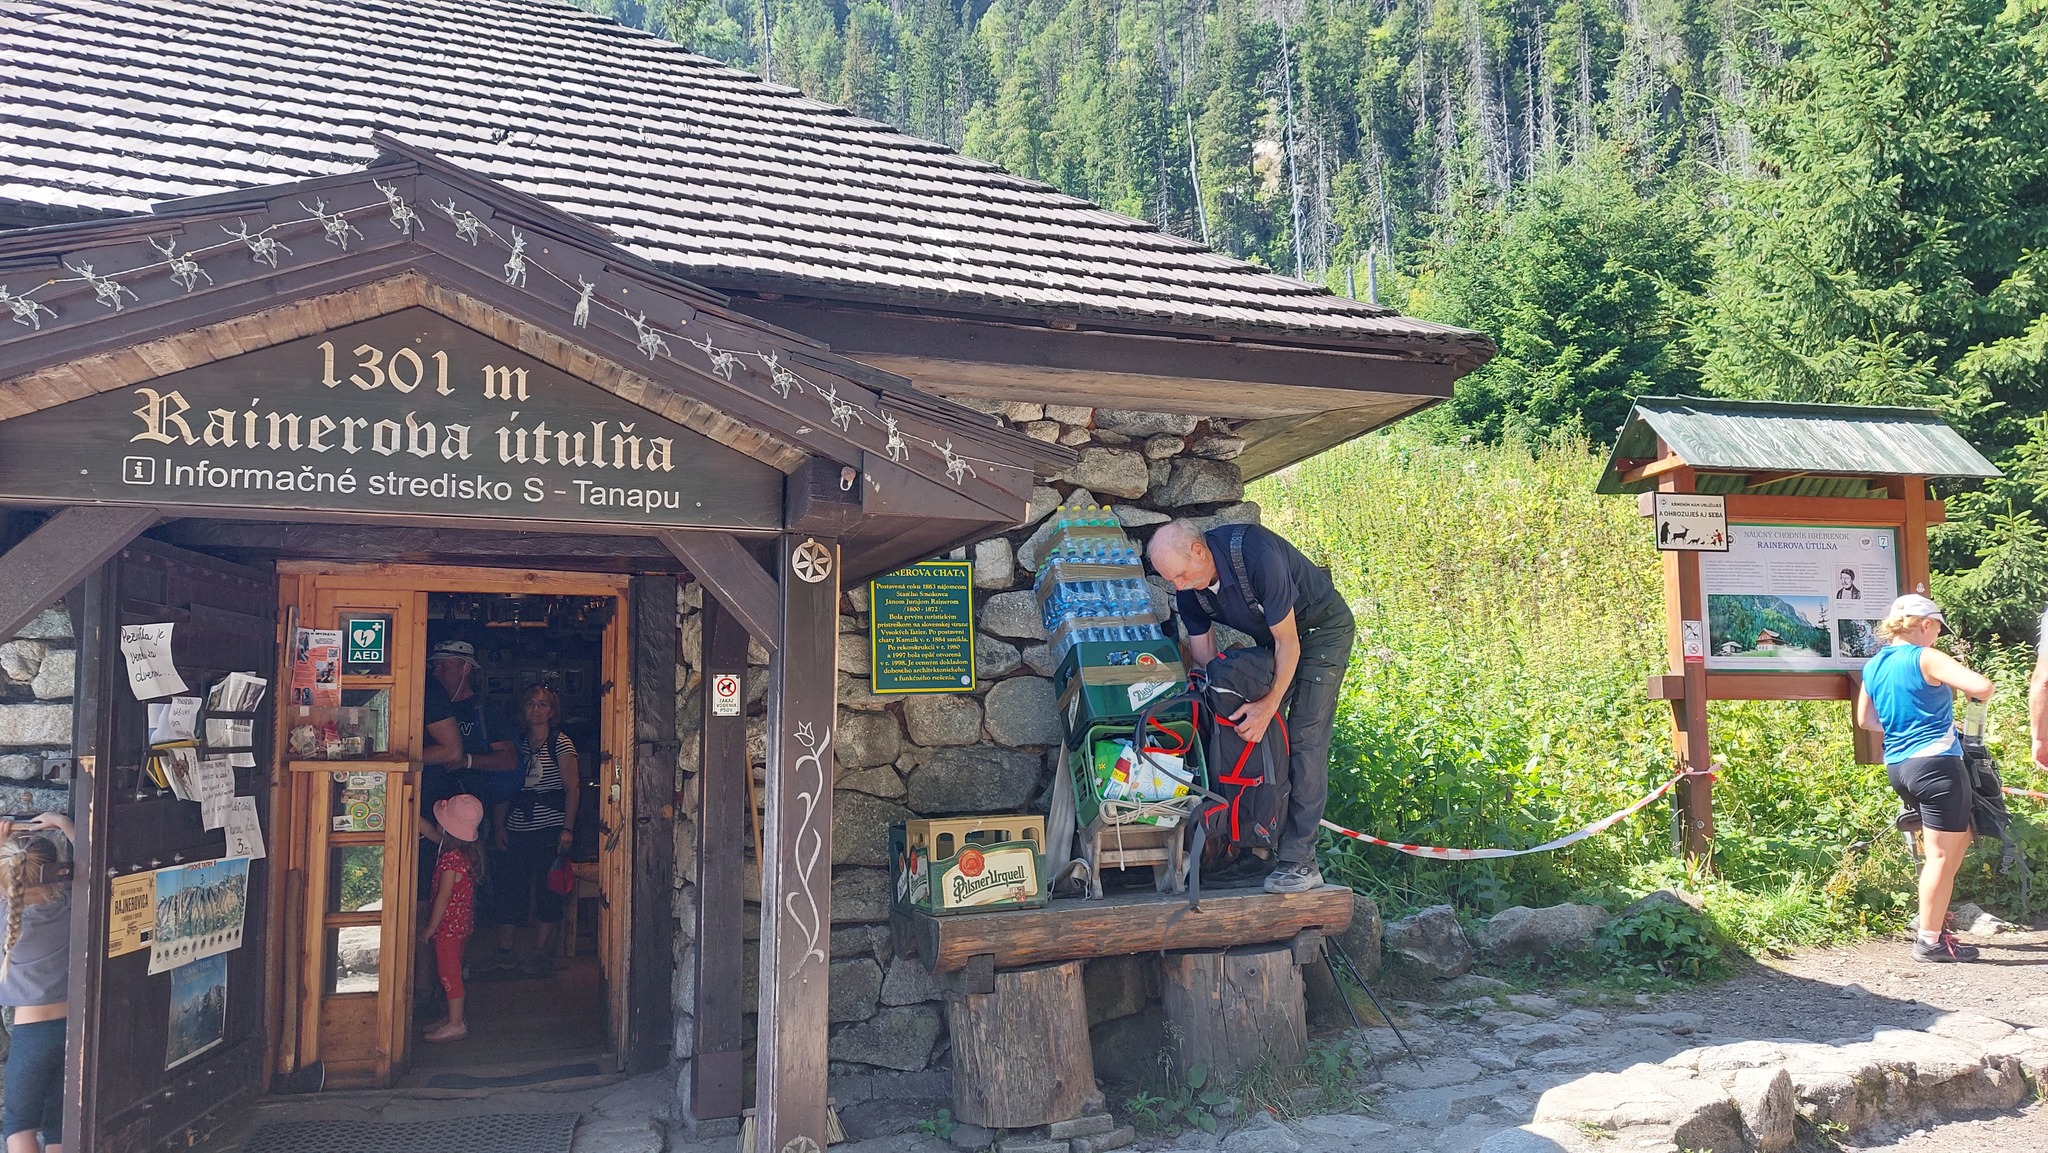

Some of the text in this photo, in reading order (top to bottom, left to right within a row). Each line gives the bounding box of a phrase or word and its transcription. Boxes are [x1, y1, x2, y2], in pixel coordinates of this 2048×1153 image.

[317, 341, 530, 402] 1301 m
[130, 388, 675, 473] Rainerova útulňa
[165, 458, 357, 495] Informačné
[368, 473, 512, 502] stredisko
[523, 477, 545, 503] S
[572, 480, 680, 514] Tanapu
[1744, 530, 1850, 540] NÁUČNÝ CHODNÍK HREBIENOK
[1757, 541, 1838, 550] RAINEROVA ÚTULŇA
[1881, 537, 1886, 545] 7
[933, 569, 965, 577] CHATA
[353, 651, 380, 660] AED
[953, 874, 990, 904] Pilsner
[988, 865, 1025, 888] Urquell
